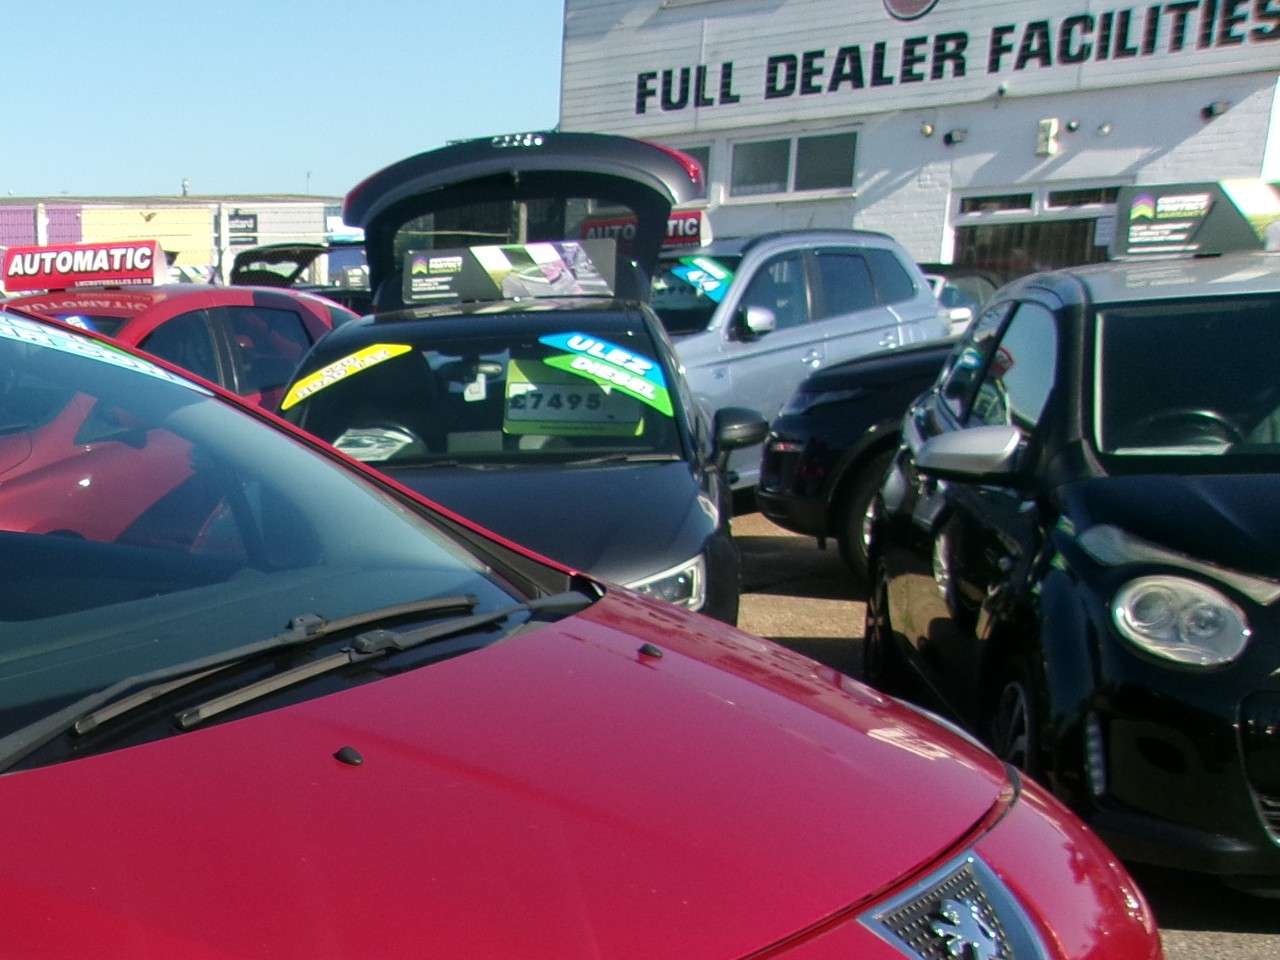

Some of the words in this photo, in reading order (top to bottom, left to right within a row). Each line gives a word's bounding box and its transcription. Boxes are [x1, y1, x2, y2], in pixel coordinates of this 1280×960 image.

[635, 62, 741, 114] FULL
[764, 31, 969, 99] DEALER
[987, 0, 1280, 74] FACILITIES
[7, 247, 152, 276] AUTOMATIC
[566, 335, 654, 377] ULEZ
[570, 356, 657, 401] DIESEL
[509, 393, 601, 411] £7495
